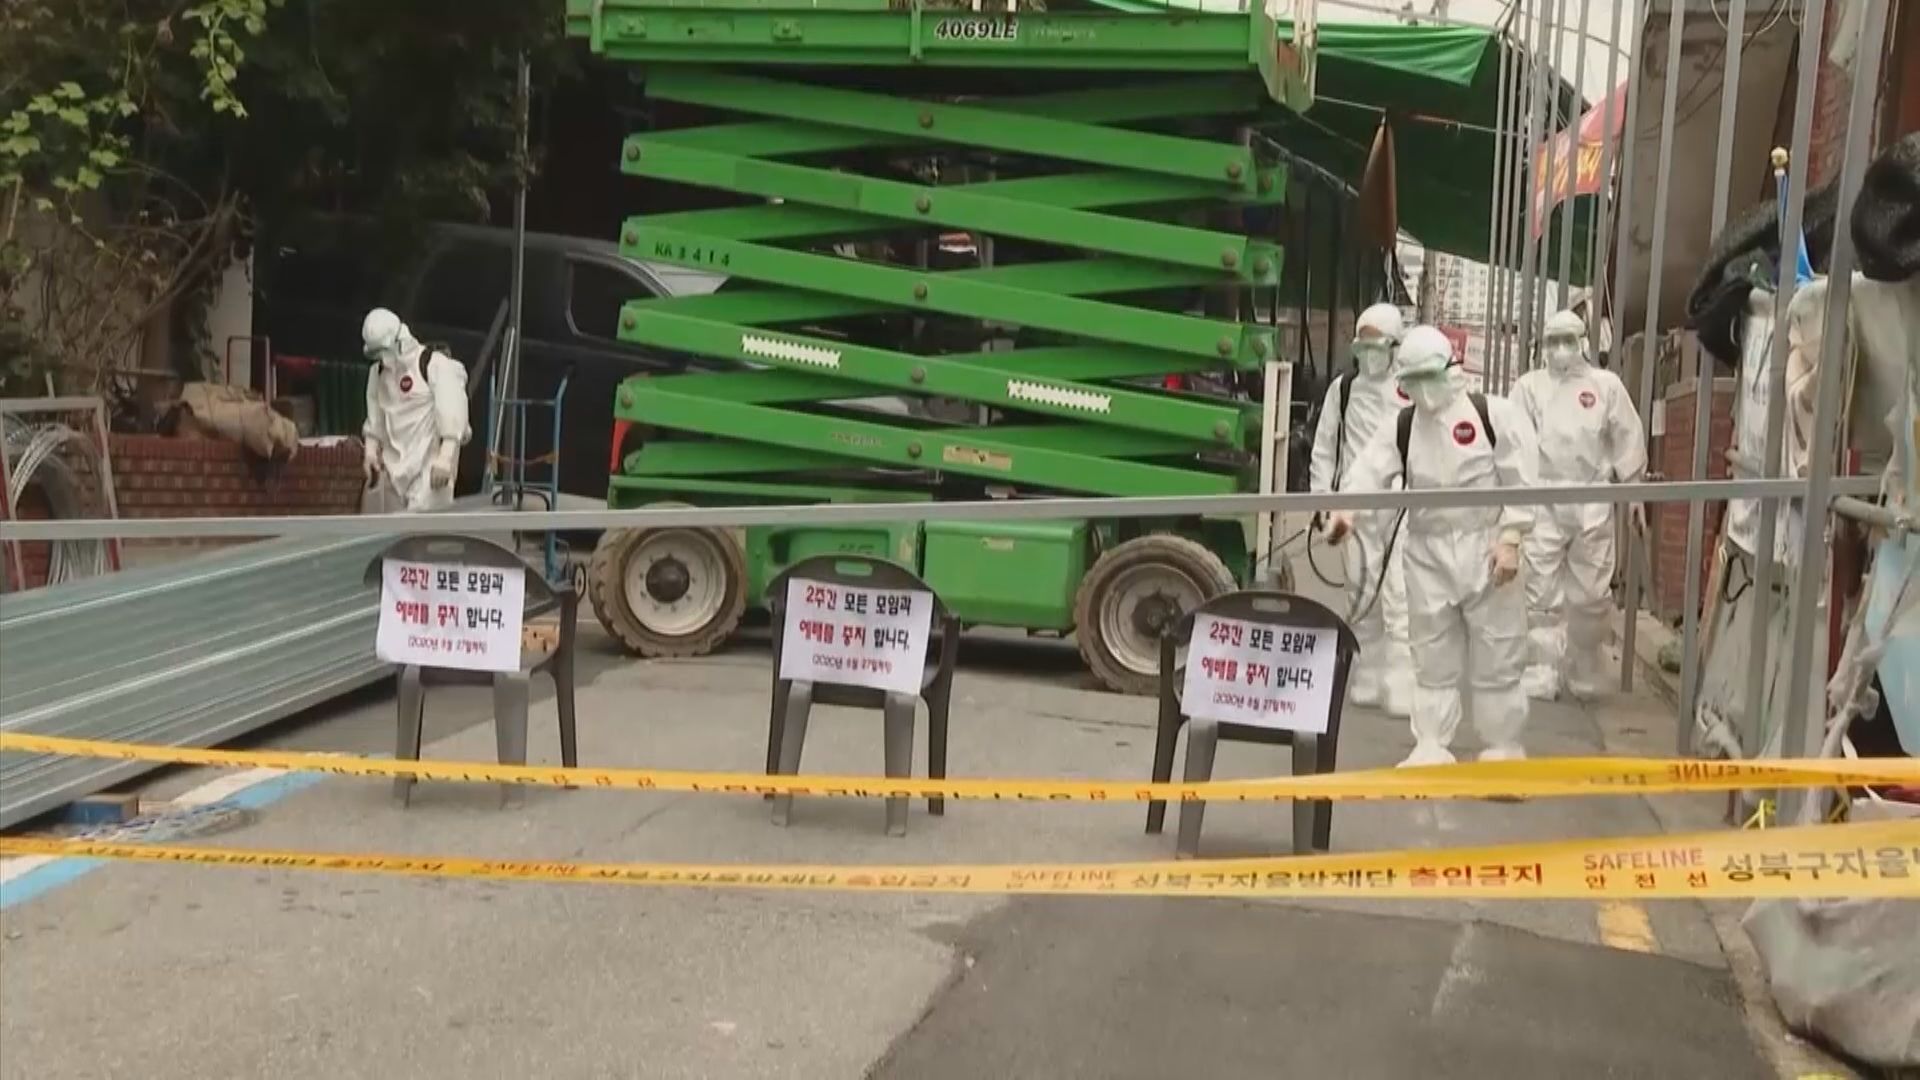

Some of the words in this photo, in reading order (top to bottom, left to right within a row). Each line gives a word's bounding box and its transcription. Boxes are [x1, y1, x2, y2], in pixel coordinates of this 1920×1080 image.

[934, 18, 1020, 41] 4069LE
[400, 567, 430, 591] 2주간
[437, 570, 460, 592] 모든
[467, 572, 504, 595] 모임과
[806, 585, 838, 610] 2주간
[844, 592, 868, 614] 모든
[875, 594, 912, 616] 모임과
[437, 604, 460, 627] 중지
[466, 607, 505, 630] 합니다.
[842, 624, 867, 648] 중지
[873, 628, 910, 653] 합니다.
[1209, 621, 1243, 647] 2주간
[1249, 628, 1274, 651] 모든
[1280, 632, 1317, 655] 모임과
[1246, 662, 1270, 687] 중지
[1276, 667, 1315, 690] 합니다.
[1584, 848, 1705, 871] SAFELINE
[1720, 847, 1920, 882] 성북구자율
[1408, 863, 1543, 887] 출입금지
